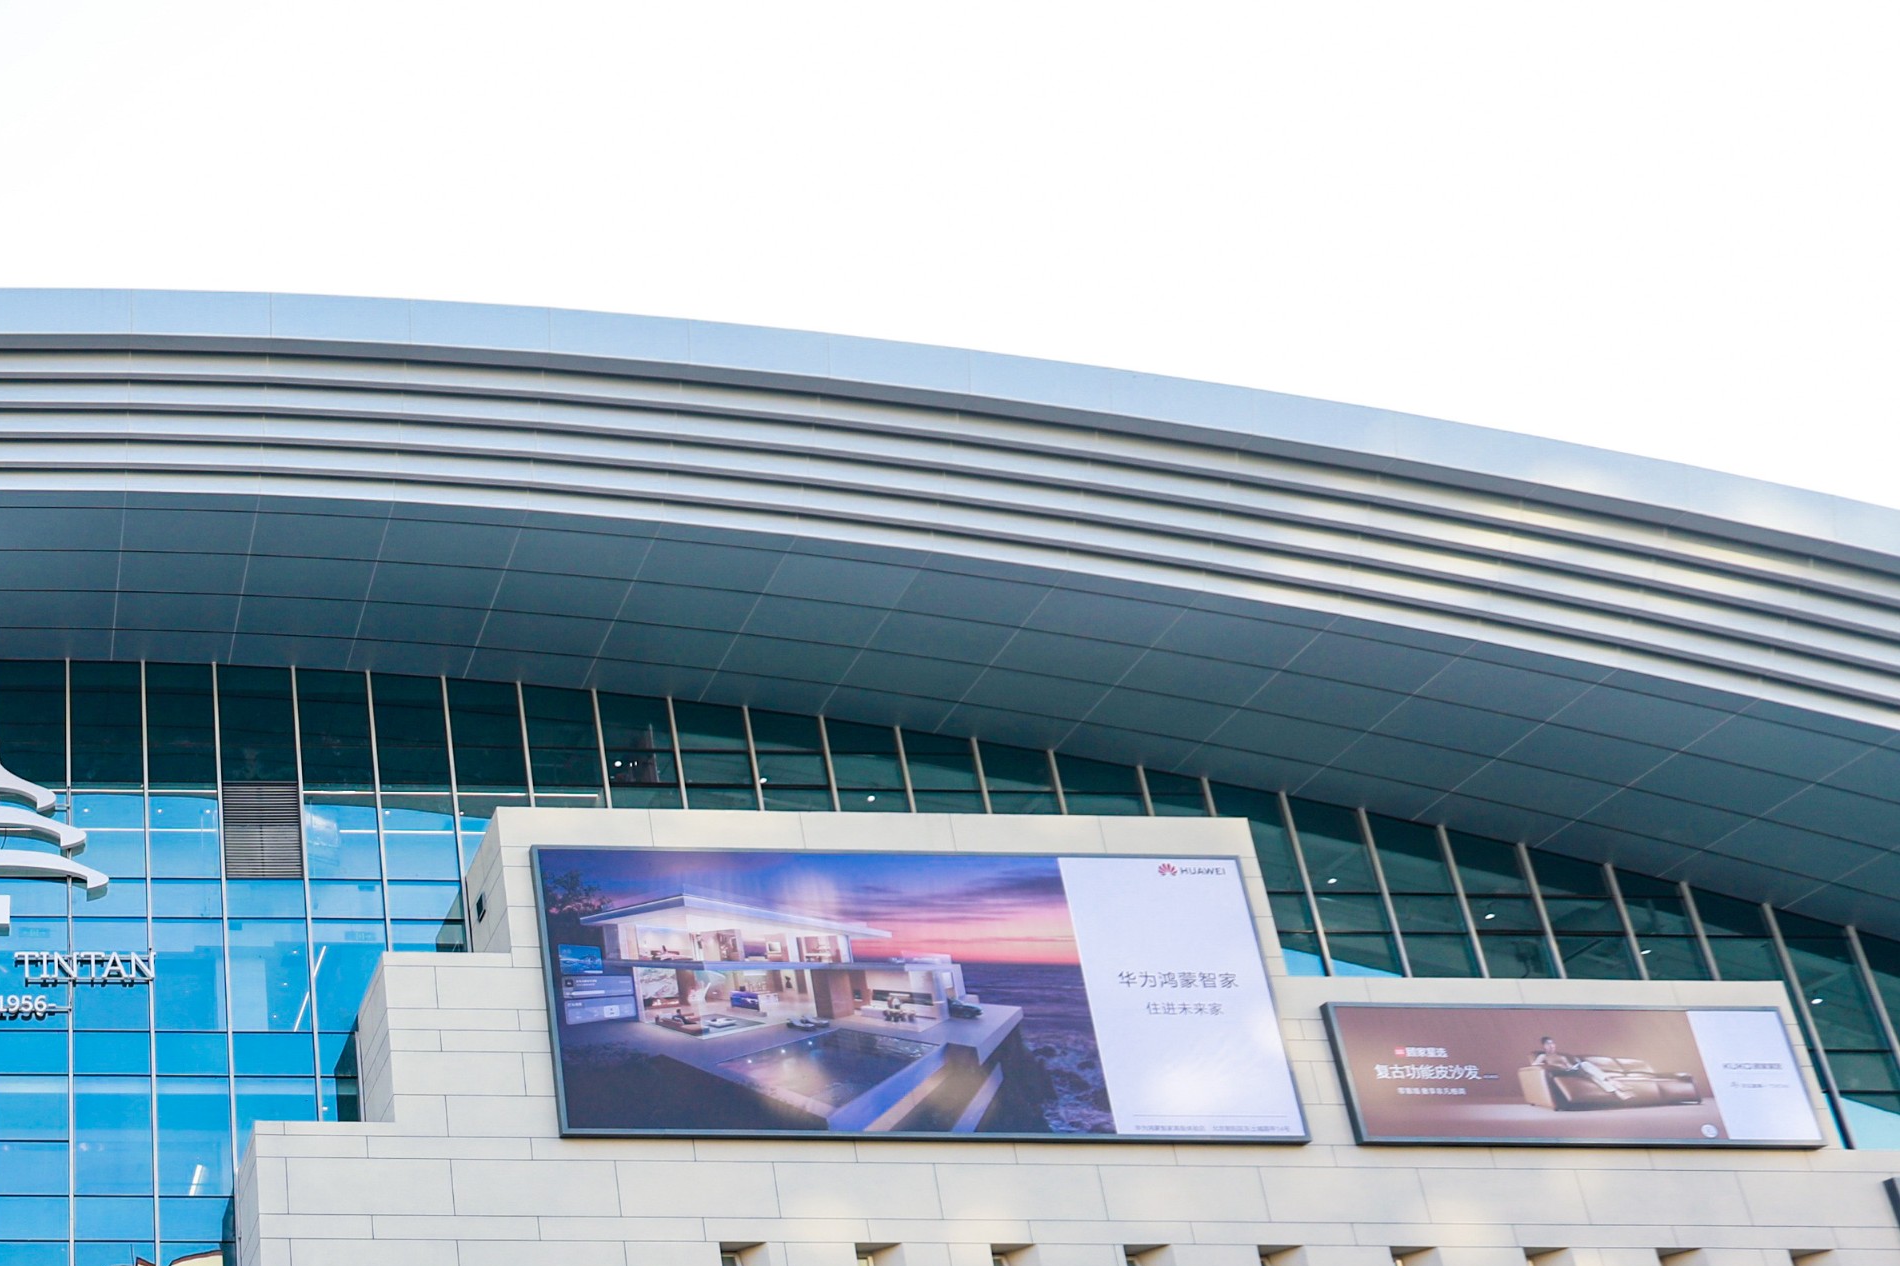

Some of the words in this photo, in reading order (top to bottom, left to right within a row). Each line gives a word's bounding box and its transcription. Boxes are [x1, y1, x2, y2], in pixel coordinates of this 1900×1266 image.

[1180, 867, 1226, 876] HUAWEI
[14, 951, 156, 982] TINTAN
[1118, 971, 1239, 988] 华为鸿蒙智家
[1146, 1002, 1224, 1015] 住进未来家
[1374, 1064, 1482, 1080] 复古功能皮沙发
